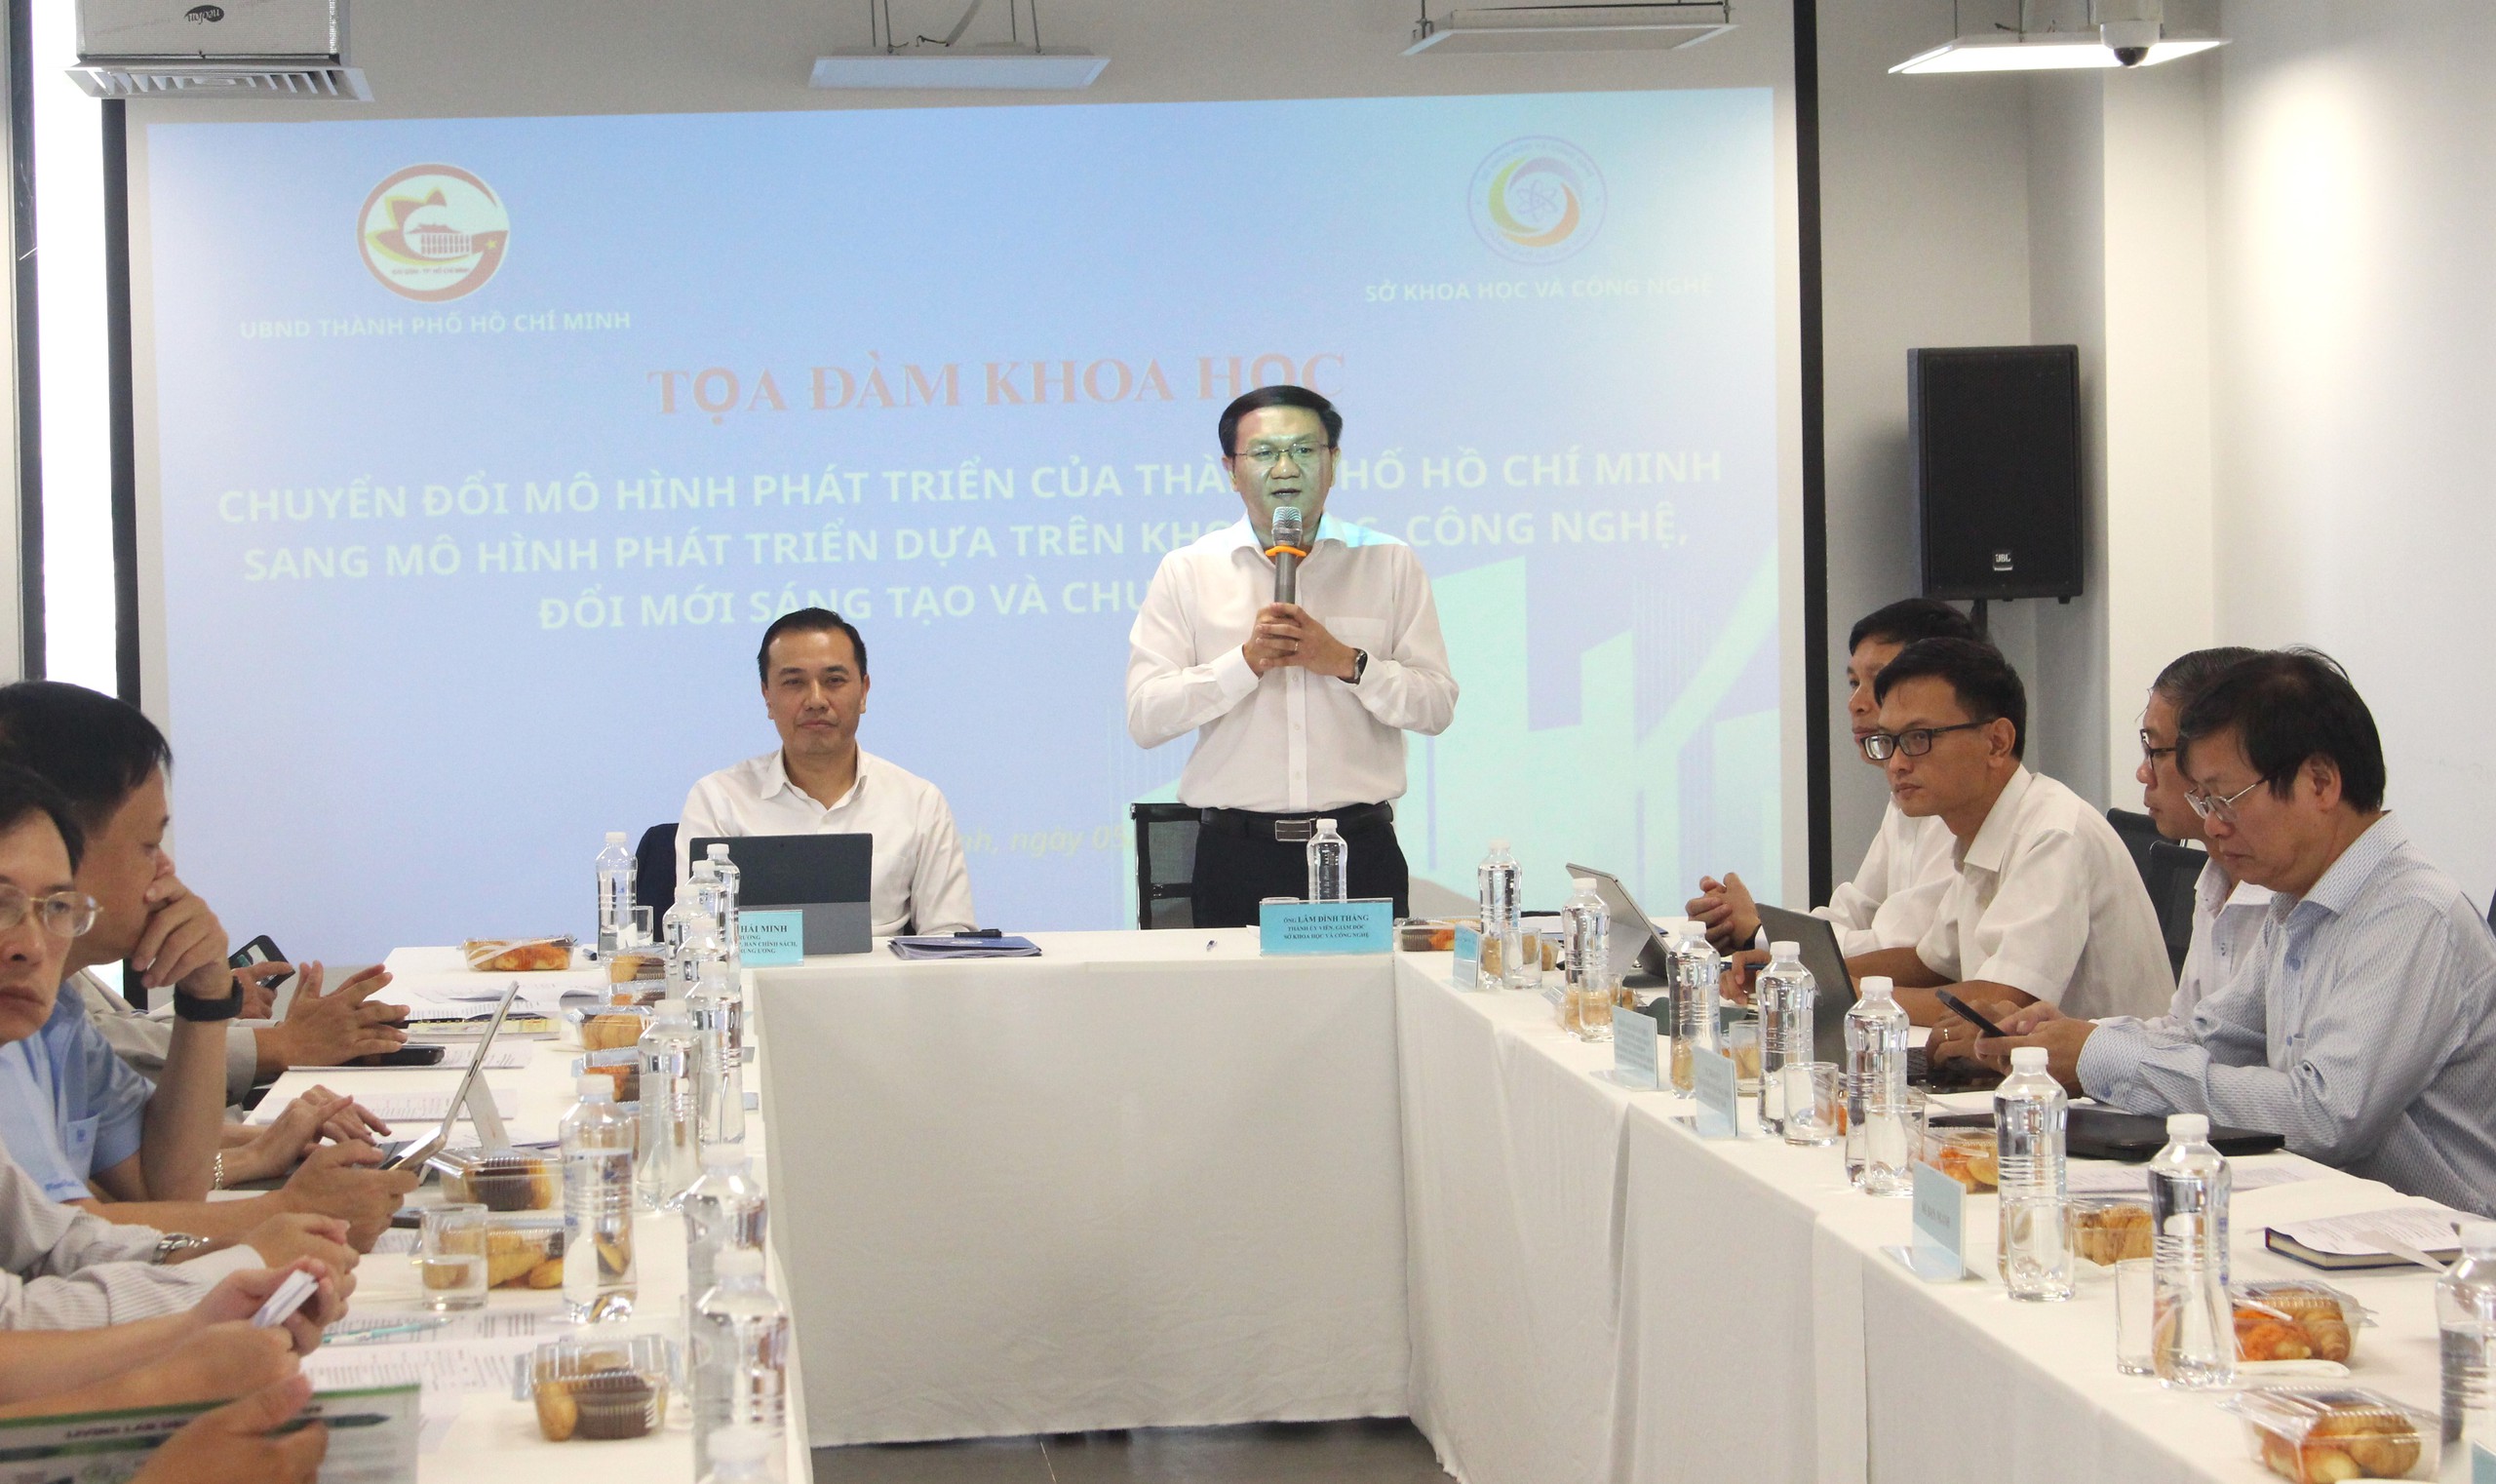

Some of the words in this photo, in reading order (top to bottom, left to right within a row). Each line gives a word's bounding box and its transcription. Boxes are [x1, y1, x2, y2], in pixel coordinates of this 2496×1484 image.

[1365, 279, 1398, 302] SỞ
[1404, 283, 1471, 301] KHOA
[1477, 282, 1528, 303] HỌC
[1533, 276, 1566, 298] VÀ
[1572, 276, 1640, 297] CÔNG
[240, 319, 311, 339] UBND
[319, 312, 403, 336] THÀNH
[412, 309, 463, 334] PHỐ
[471, 310, 506, 333] HỒ
[514, 309, 557, 332] CHÍ
[565, 312, 632, 331] MINH
[646, 367, 789, 425] TỌA
[807, 350, 964, 410] ĐÀM
[983, 357, 1176, 406] KHOA
[218, 473, 407, 524] CHUYỂN
[422, 468, 510, 518] ĐỔI
[525, 472, 601, 514] MÔ
[616, 469, 736, 511] HÌNH
[753, 463, 870, 507] PHÁT
[882, 454, 1015, 502] TRIỂN
[1032, 454, 1122, 498] CỦA
[1135, 454, 1230, 495] THÀ
[1341, 447, 1406, 490] HỐ
[1423, 446, 1487, 488] HỒ
[1502, 445, 1581, 488] CHÍ
[1596, 450, 1721, 486] MINH
[243, 544, 370, 581] SANG
[387, 534, 461, 577] MÔ
[479, 532, 599, 573] HÌNH
[616, 526, 731, 569] PHÁT
[745, 518, 878, 565] TRIỂN
[896, 525, 996, 566] DỰA
[1010, 516, 1123, 558] TRÊN
[1406, 505, 1535, 547] CÔNG
[1551, 501, 1688, 550] NGHỆ,
[1995, 553, 2011, 563] JBL
[538, 584, 624, 630] ĐỔI
[641, 584, 735, 626] MỚI
[750, 581, 872, 623] SÁNG
[886, 584, 975, 625] TẠO
[990, 574, 1048, 615] VÀ
[1010, 825, 1084, 859] ngày
[760, 924, 788, 933] MINH
[1298, 914, 1316, 923] LÂM
[1318, 914, 1340, 922] ĐÌNH
